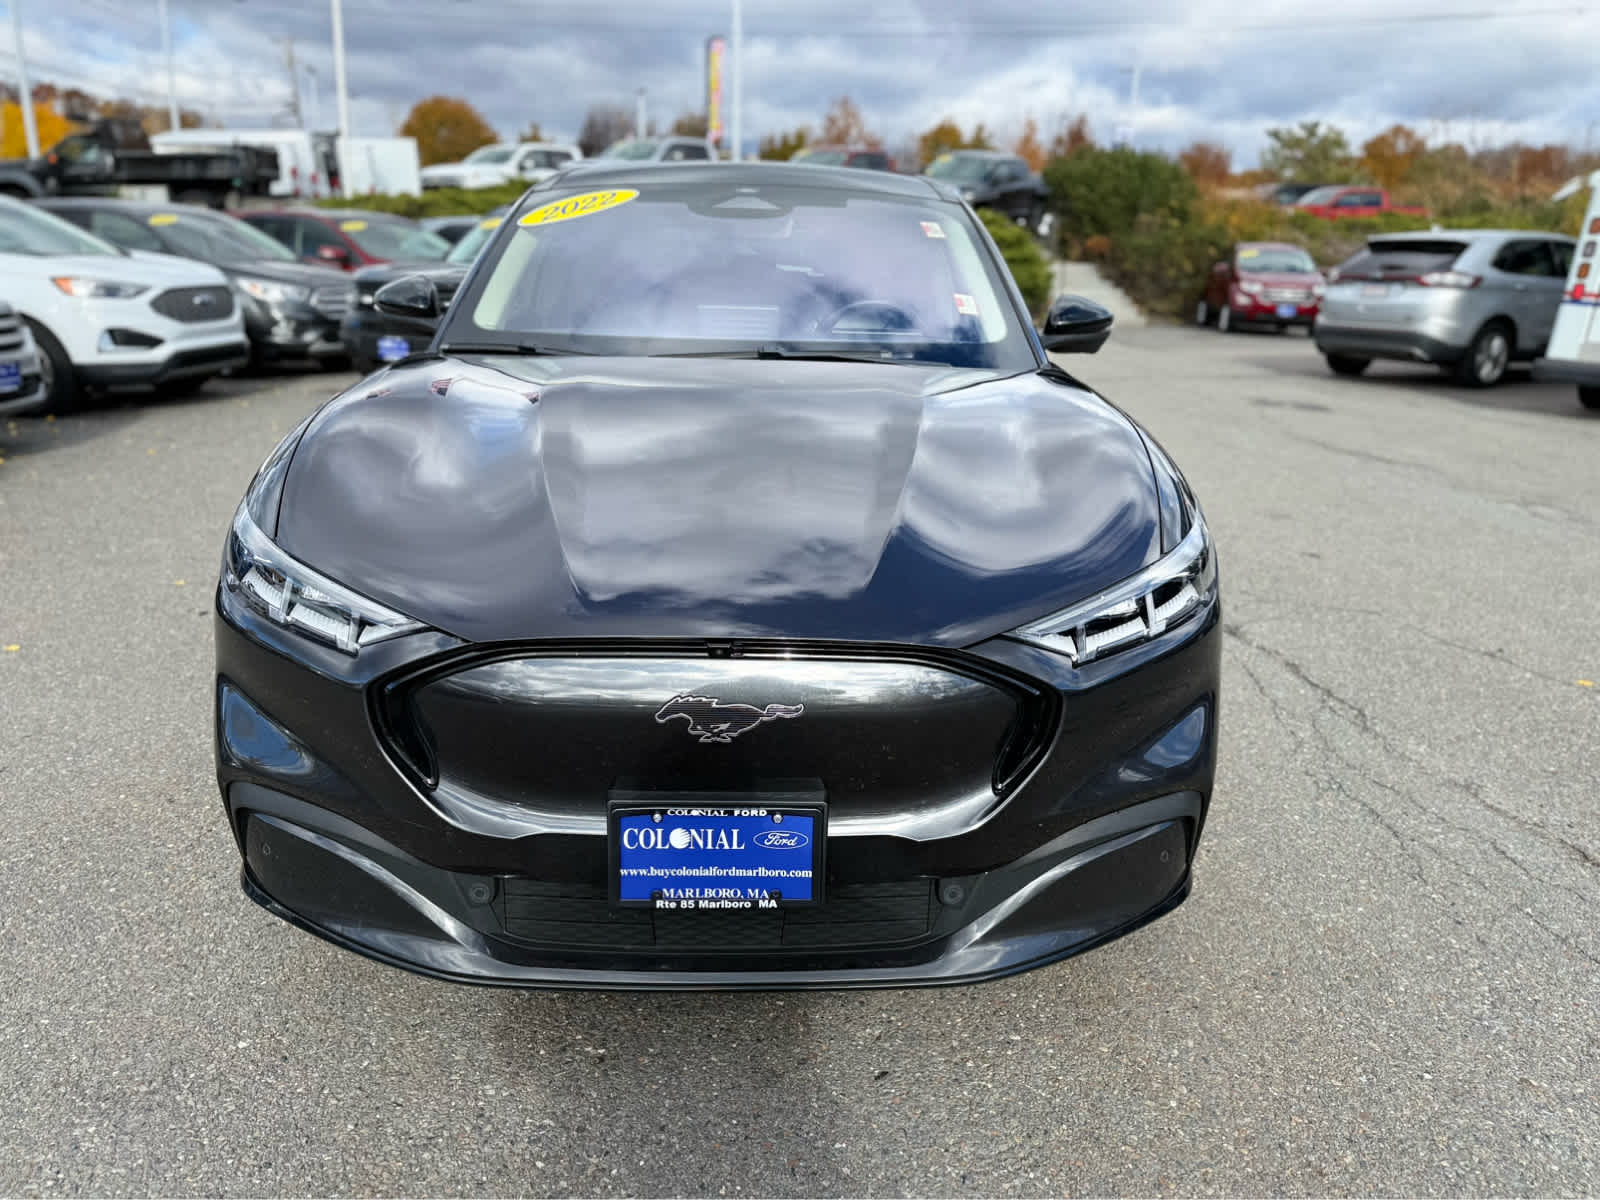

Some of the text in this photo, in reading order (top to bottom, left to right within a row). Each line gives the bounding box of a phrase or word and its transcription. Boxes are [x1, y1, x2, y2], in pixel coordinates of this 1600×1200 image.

[543, 190, 618, 220] 2022
[667, 808, 767, 817] COLONIAL FORD
[623, 827, 745, 850] COLONIAL
[763, 832, 798, 847] Ford
[620, 866, 812, 879] www.buycolonialfordmarlboro.com
[747, 888, 769, 899] MA
[656, 900, 778, 909] Rte 85 Marlboro MA
